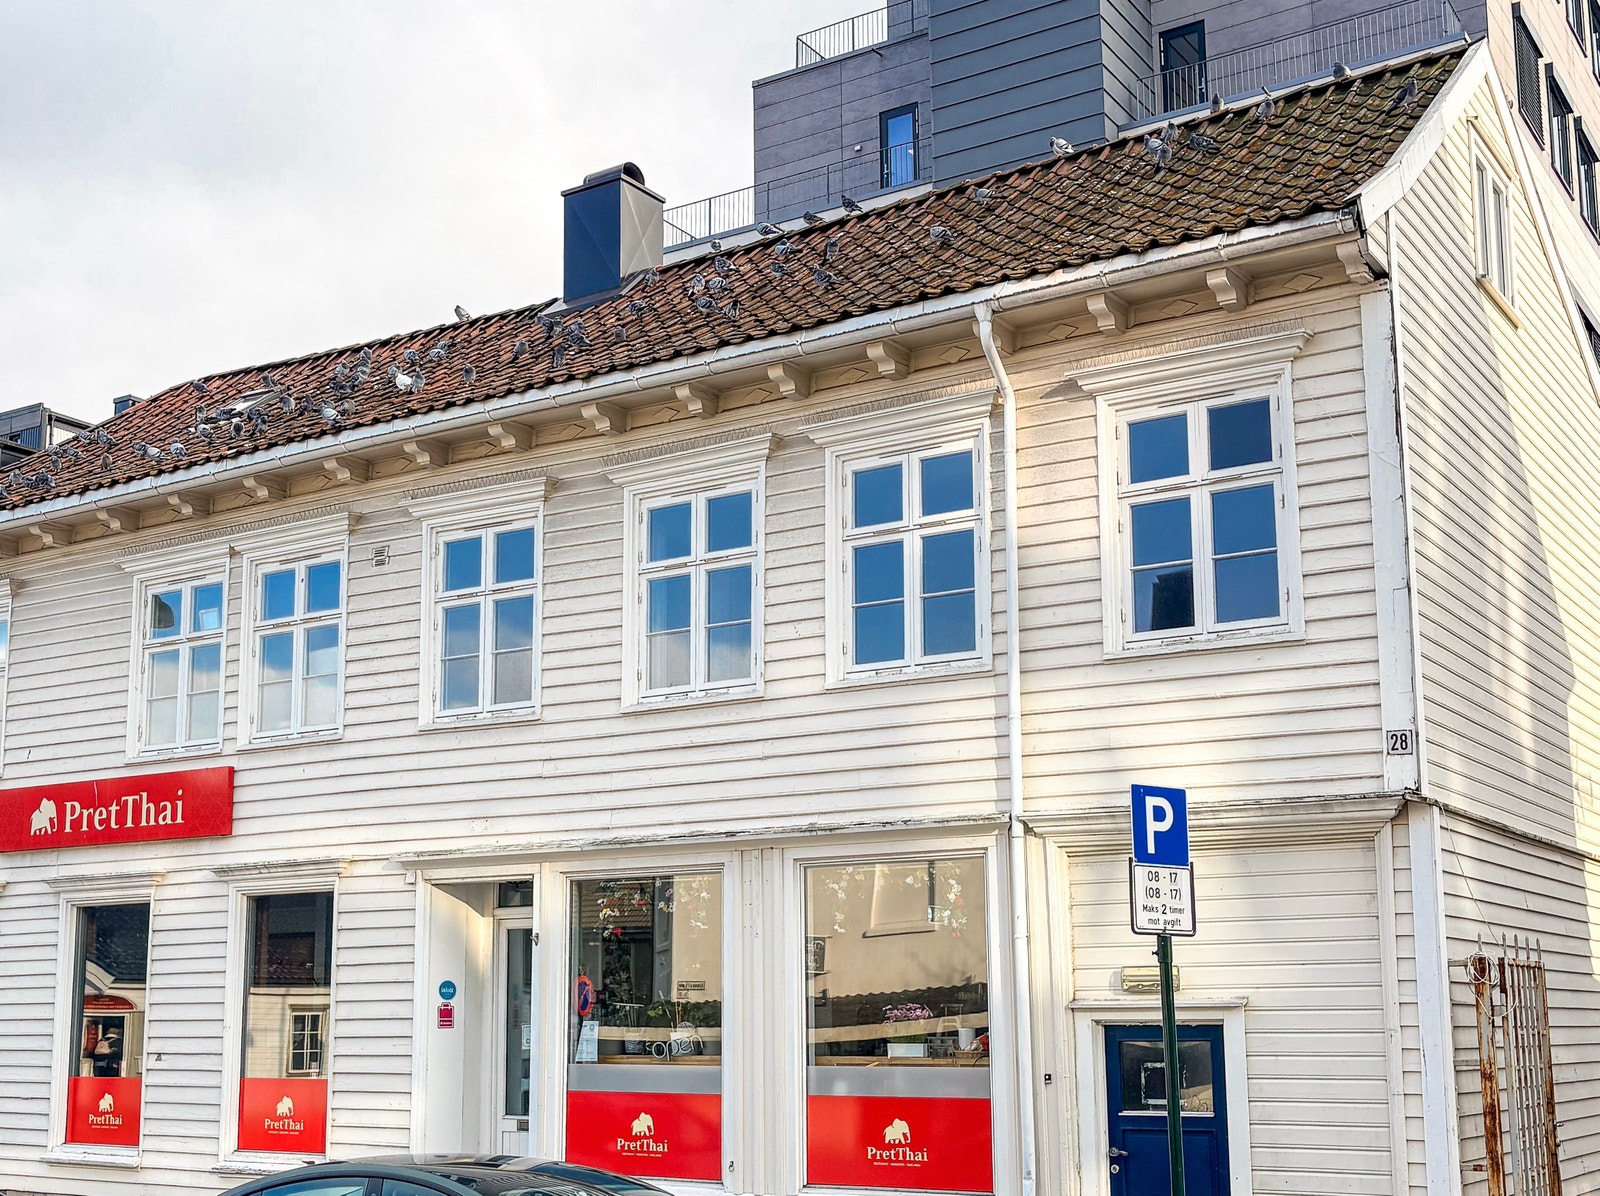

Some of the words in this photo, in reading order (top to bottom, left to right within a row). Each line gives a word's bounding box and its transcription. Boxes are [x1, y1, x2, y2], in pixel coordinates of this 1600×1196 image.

[1390, 733, 1408, 751] 28
[64, 789, 185, 833] PretThai
[1145, 795, 1174, 854] P
[1147, 870, 1160, 882] 08
[1169, 872, 1178, 883] 17
[1145, 885, 1161, 899] (08
[1169, 887, 1182, 901] 17)
[1142, 903, 1159, 913] Maks
[1161, 903, 1167, 915] 2
[1169, 905, 1185, 915] timer
[1147, 917, 1160, 926] mot
[1163, 917, 1182, 928] avgift
[652, 1034, 704, 1061] open
[88, 1113, 123, 1125] PretThai
[264, 1118, 304, 1130] PretThai
[617, 1137, 668, 1152] PretThai
[867, 1146, 928, 1162] PretThai
